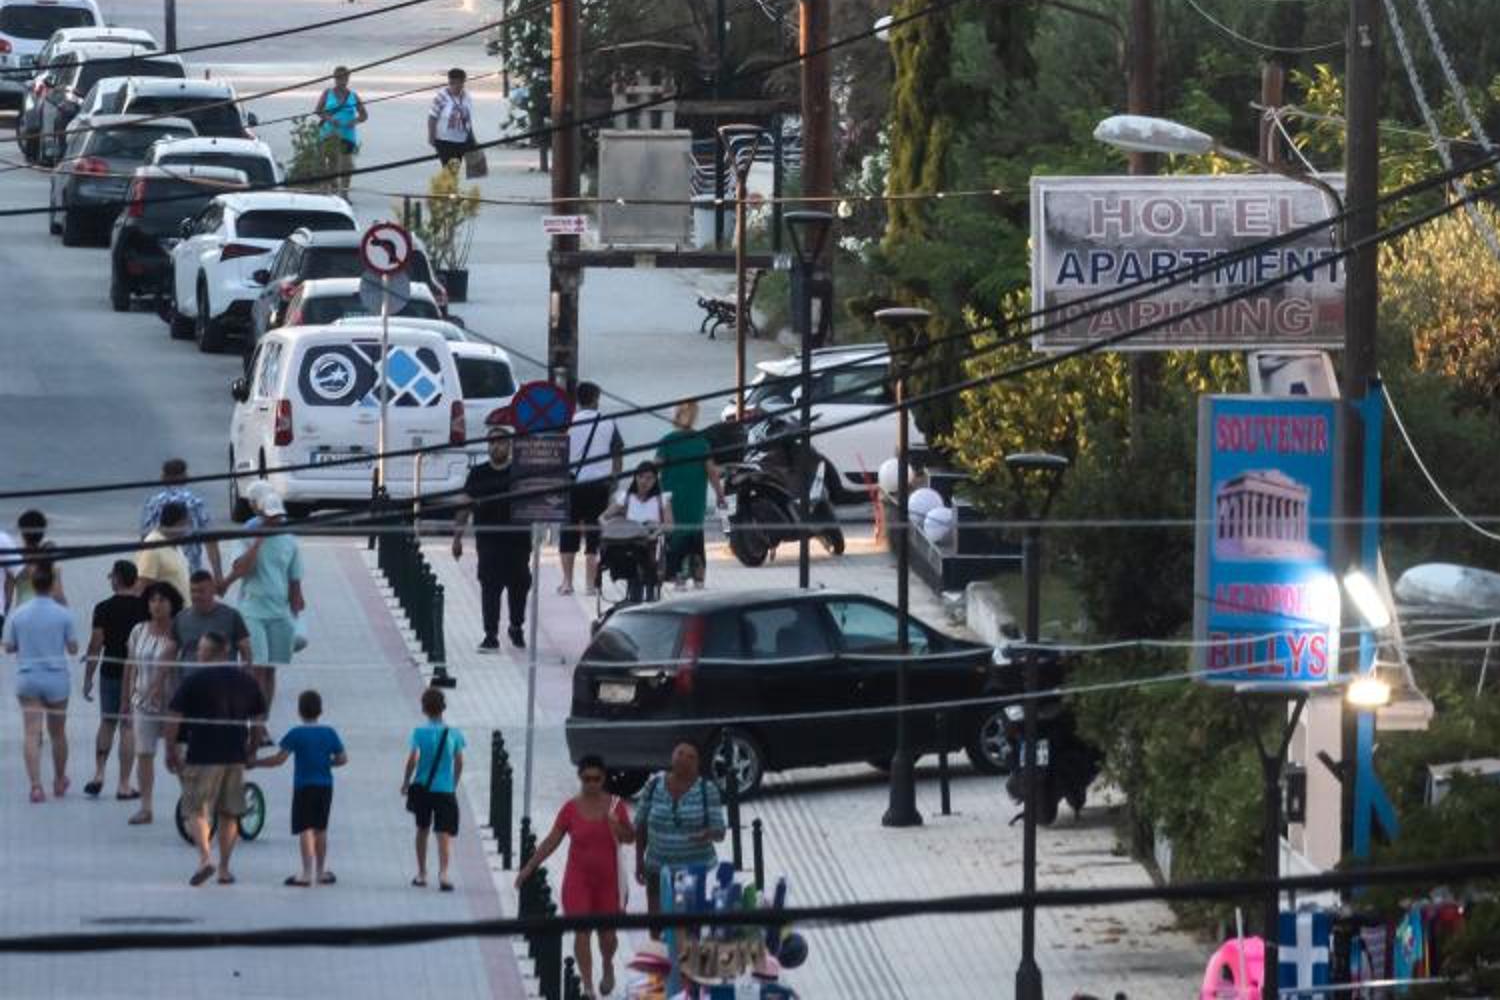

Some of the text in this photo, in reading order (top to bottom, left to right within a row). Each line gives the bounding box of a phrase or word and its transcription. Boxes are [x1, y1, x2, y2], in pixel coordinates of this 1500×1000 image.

[1088, 195, 1310, 238] HOTEL
[1056, 247, 1344, 286] APARTMENT
[1055, 296, 1314, 337] PARKING
[1207, 632, 1328, 676] BILLYS
